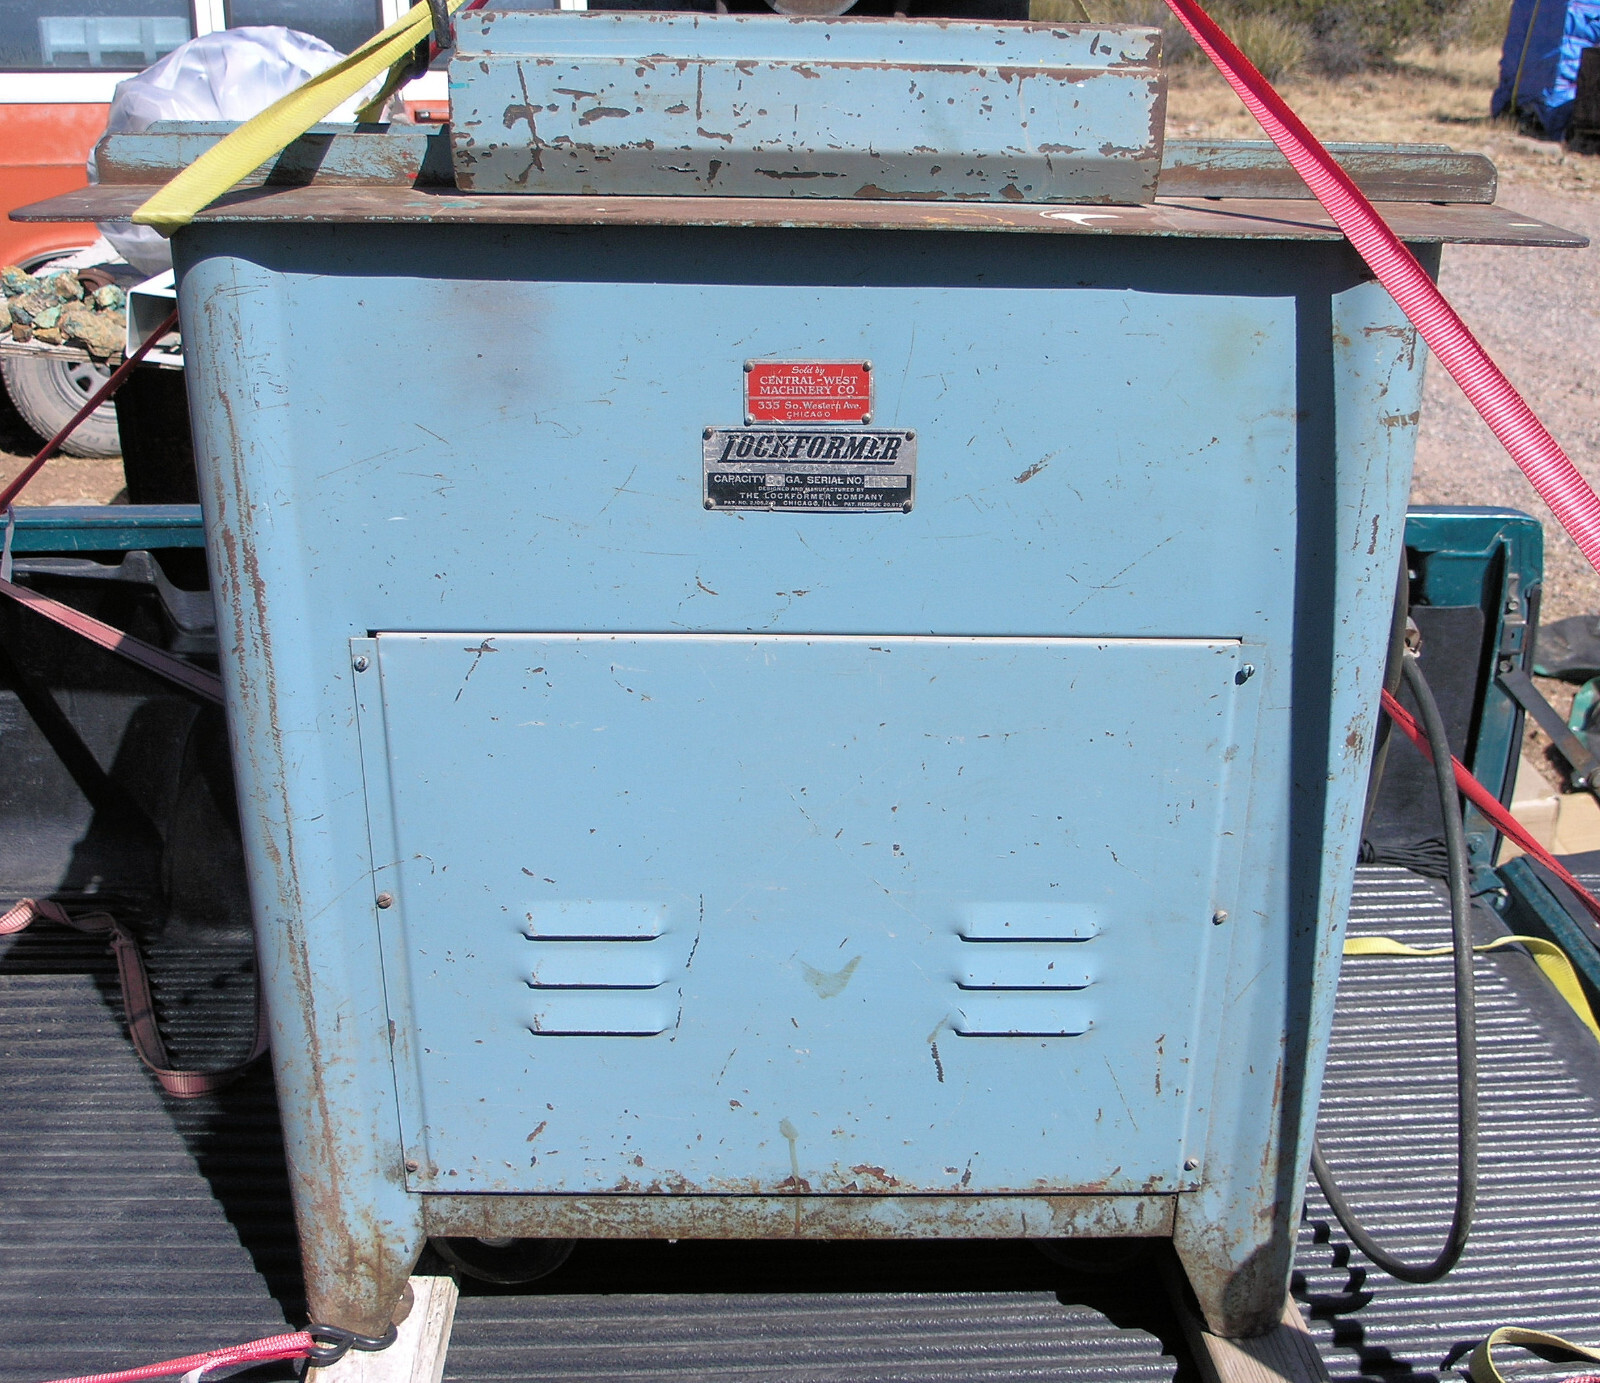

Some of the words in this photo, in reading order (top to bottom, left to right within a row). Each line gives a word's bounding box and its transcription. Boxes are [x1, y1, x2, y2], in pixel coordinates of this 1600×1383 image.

[792, 366, 812, 374] Sold
[815, 366, 825, 376] by
[760, 386, 832, 395] MACHINERY
[838, 386, 858, 394] CO.
[758, 401, 780, 410] 335
[784, 401, 802, 410] So.
[802, 402, 841, 410] Western
[843, 402, 862, 410] Ave.
[718, 434, 902, 463] LOCKFORMER
[714, 474, 765, 484] CAPACITY
[786, 476, 803, 484] GA.
[807, 476, 844, 484] SERIAL
[846, 476, 864, 485] NO.
